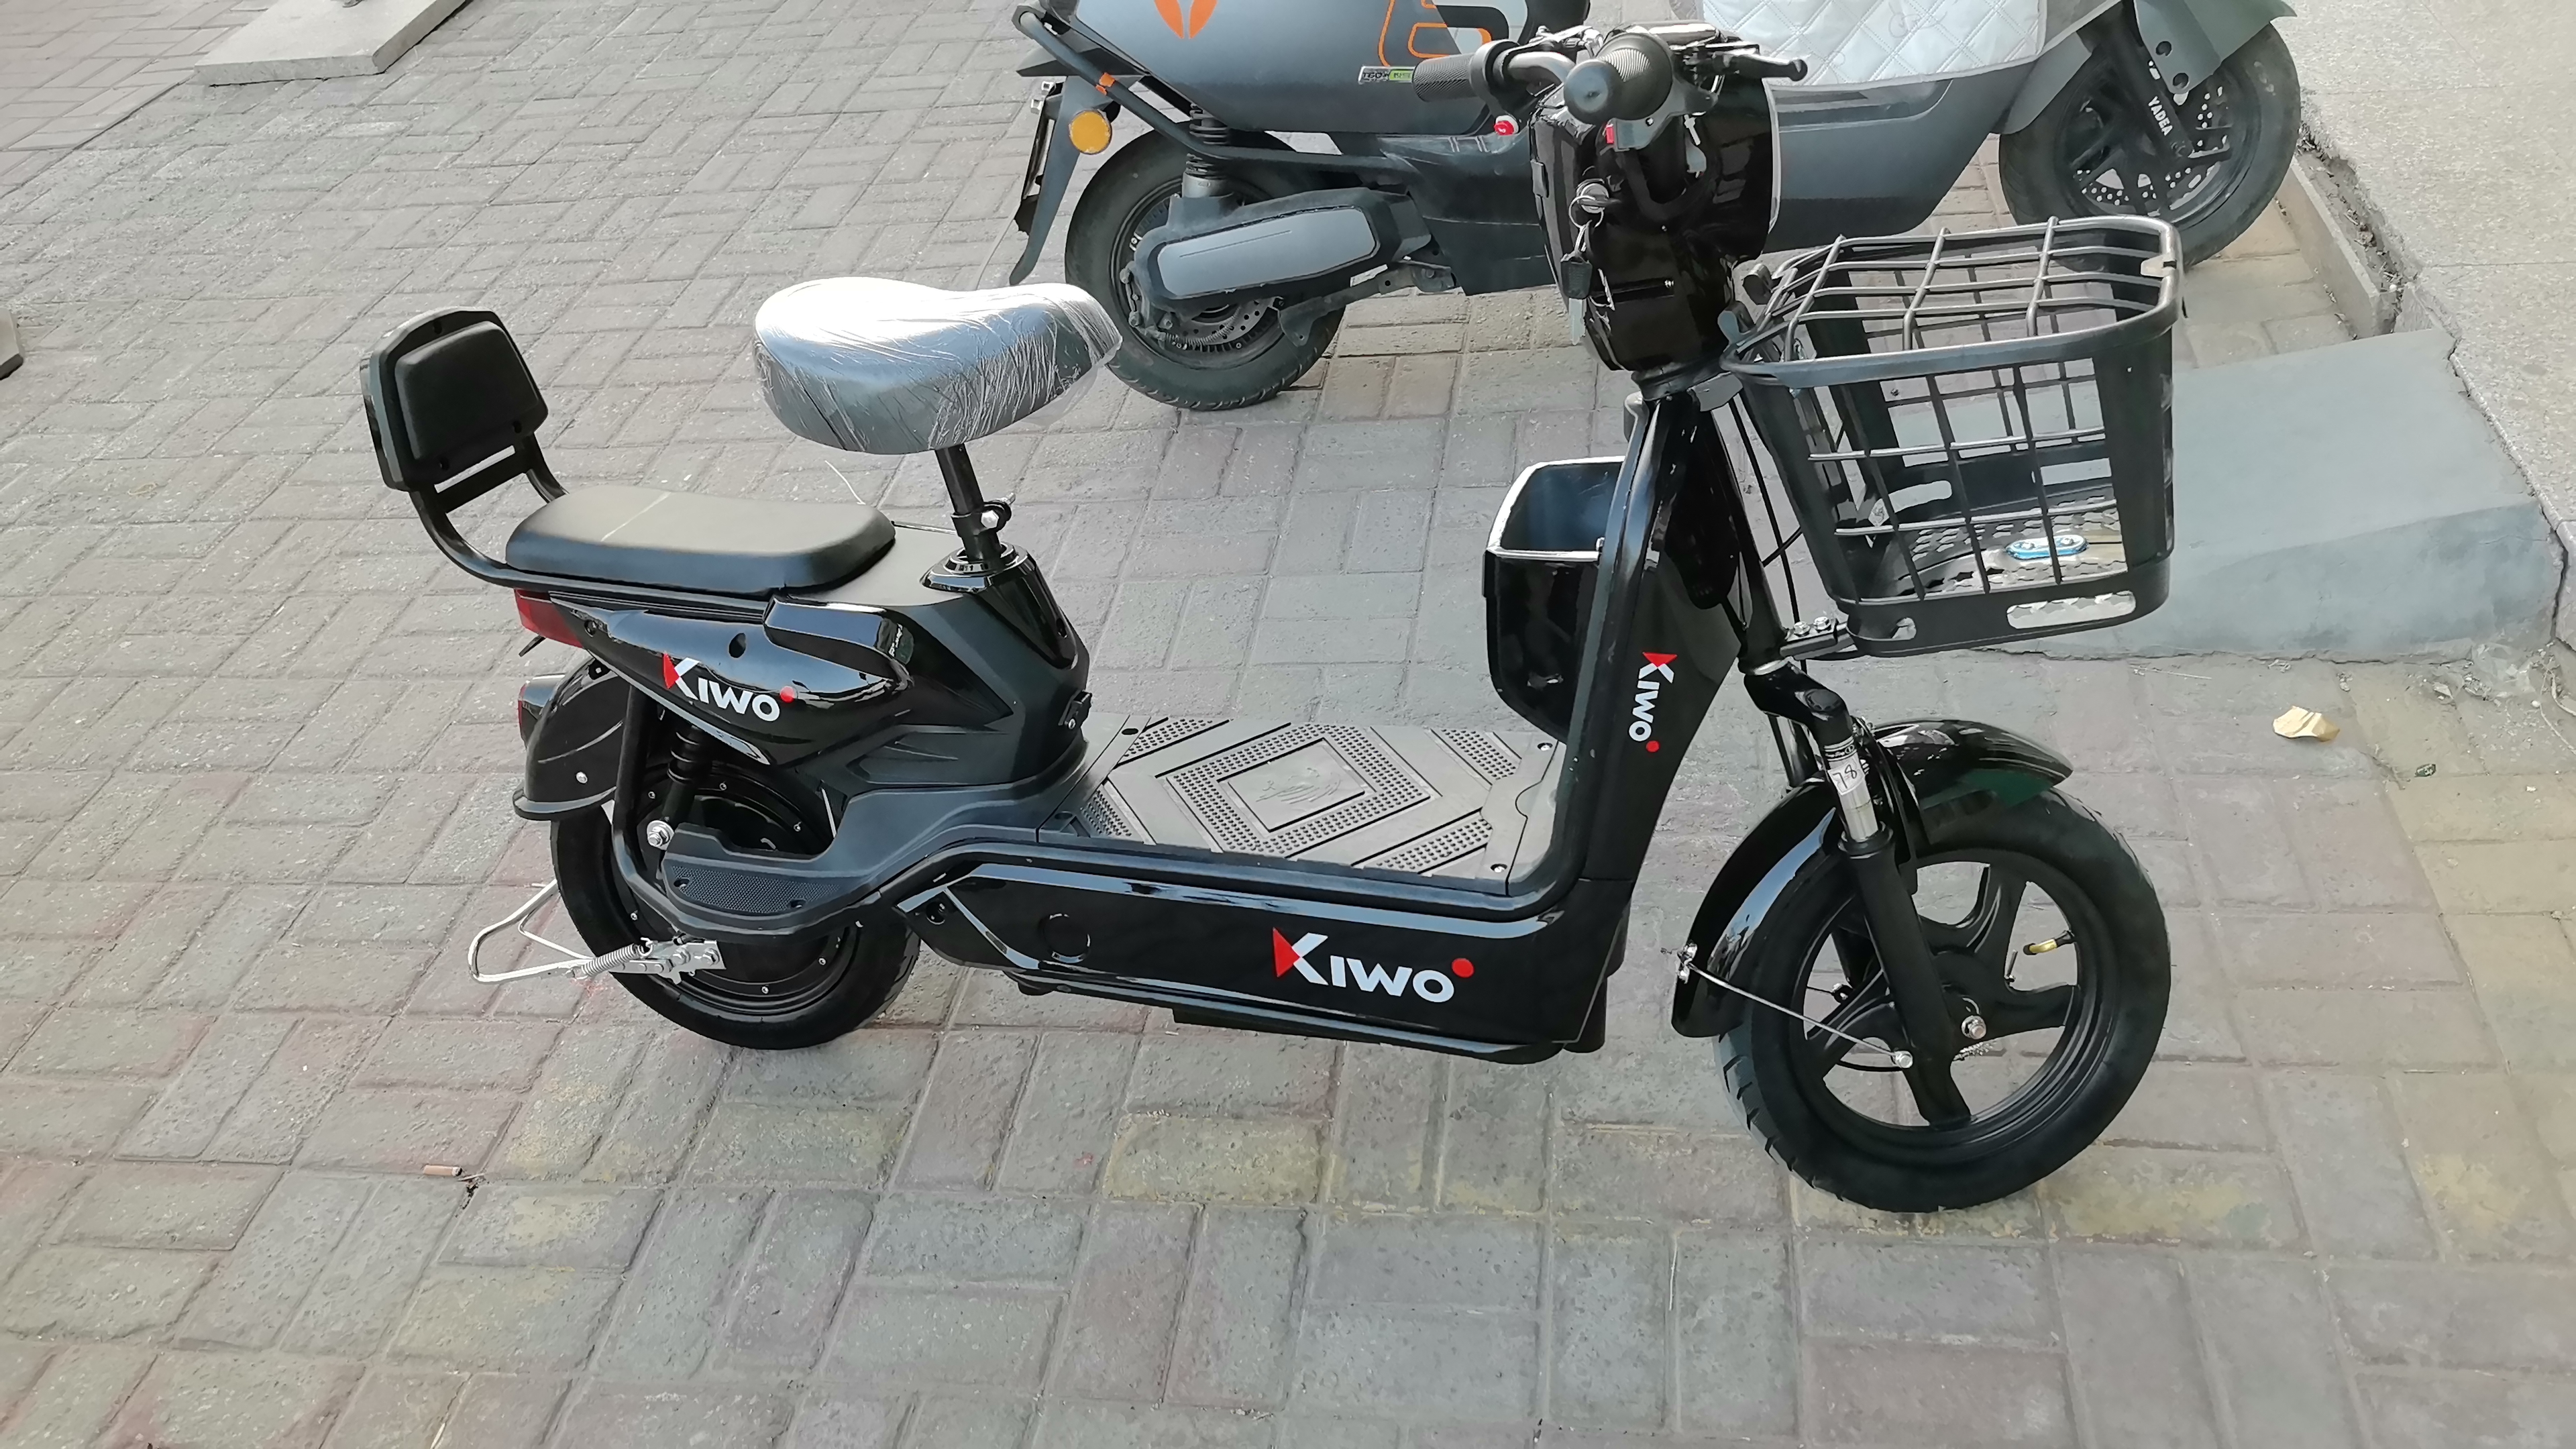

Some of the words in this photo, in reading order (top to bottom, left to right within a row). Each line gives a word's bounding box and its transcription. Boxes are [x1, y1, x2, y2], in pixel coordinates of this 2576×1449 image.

[2148, 95, 2173, 136] YADEA
[663, 652, 780, 722] KIWO
[1629, 651, 1677, 741] KIWO
[1273, 927, 1454, 1003] KIWO
